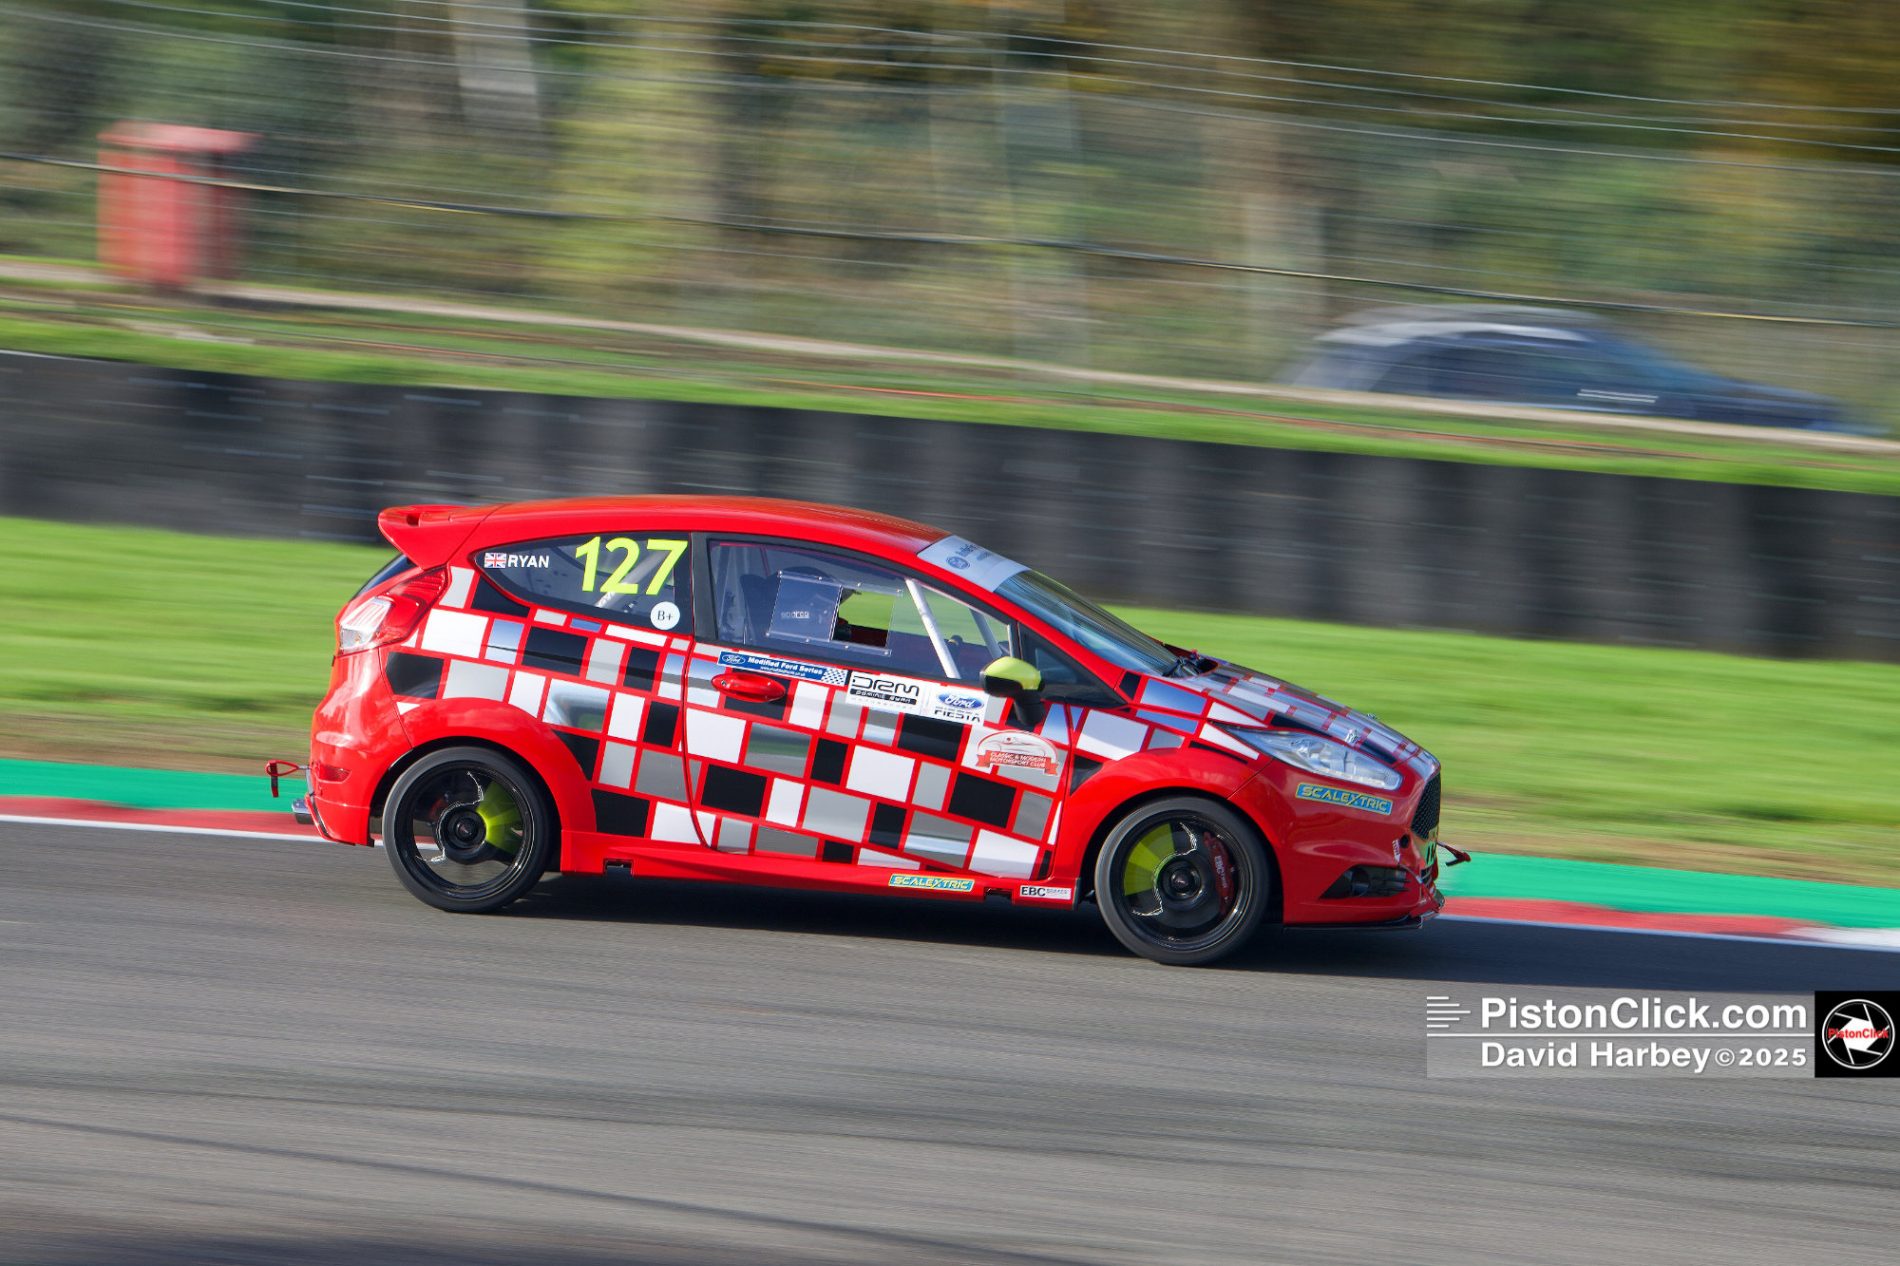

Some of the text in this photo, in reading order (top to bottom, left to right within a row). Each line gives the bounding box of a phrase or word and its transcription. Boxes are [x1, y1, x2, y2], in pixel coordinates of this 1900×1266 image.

[507, 555, 550, 569] RYAN
[575, 536, 688, 596] 127
[657, 609, 674, 622] B+
[747, 657, 780, 667] Modified
[781, 662, 798, 670] Ford
[799, 665, 823, 676] Series
[934, 706, 981, 722] FIESTA
[1302, 786, 1388, 812] SCALEXTRIC
[894, 876, 970, 890] SCALEXTRIC
[1021, 886, 1046, 897] EBC
